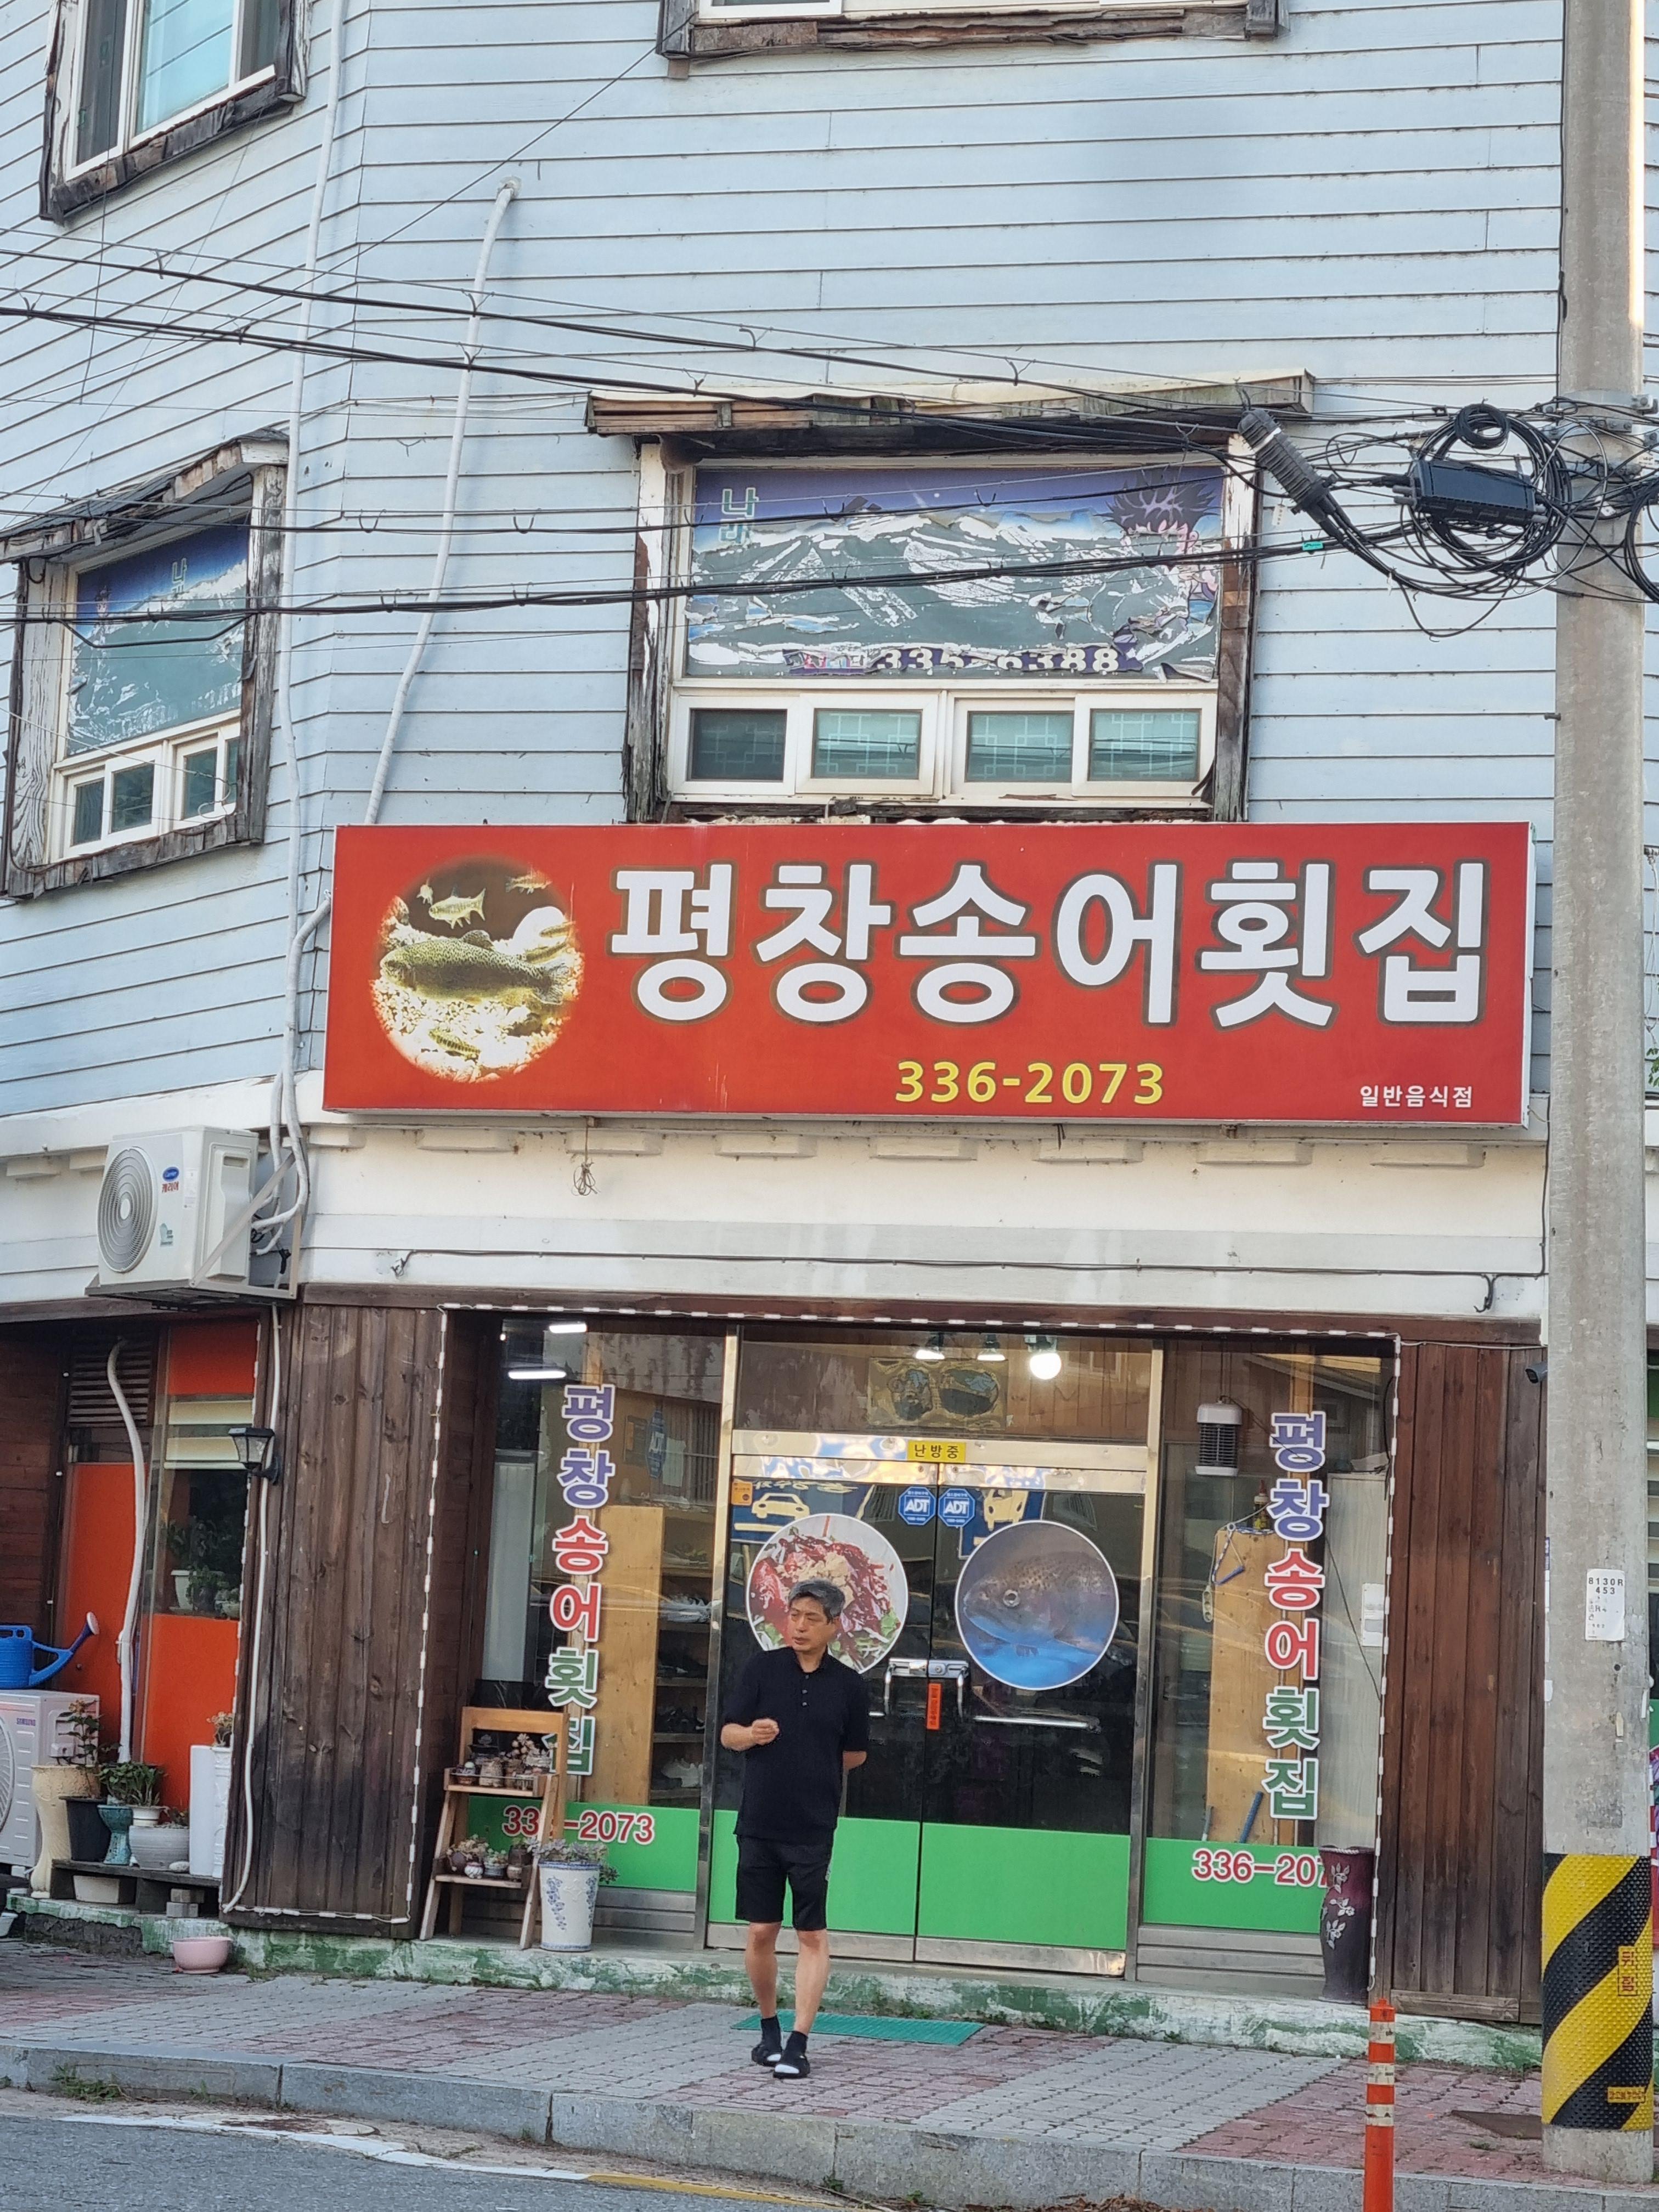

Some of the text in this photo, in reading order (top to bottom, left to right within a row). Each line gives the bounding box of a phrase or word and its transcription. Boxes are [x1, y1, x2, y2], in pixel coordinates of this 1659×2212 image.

[610, 862, 1485, 1029] 평창송어횟집
[895, 1060, 1164, 1104] 336-2073
[1359, 1084, 1473, 1108] 일반음식점
[914, 1444, 959, 1459] 난방중
[905, 1498, 930, 1513] ADT
[943, 1500, 969, 1515] ADT
[541, 1384, 615, 1775] 평창송어횟집
[1588, 1577, 1623, 1587] 8130R
[1595, 1586, 1615, 1595] 453
[1262, 1410, 1330, 1820] 평창송어횟집
[502, 1804, 655, 1846] 33-2073
[1191, 1848, 1328, 1888] 336-20
